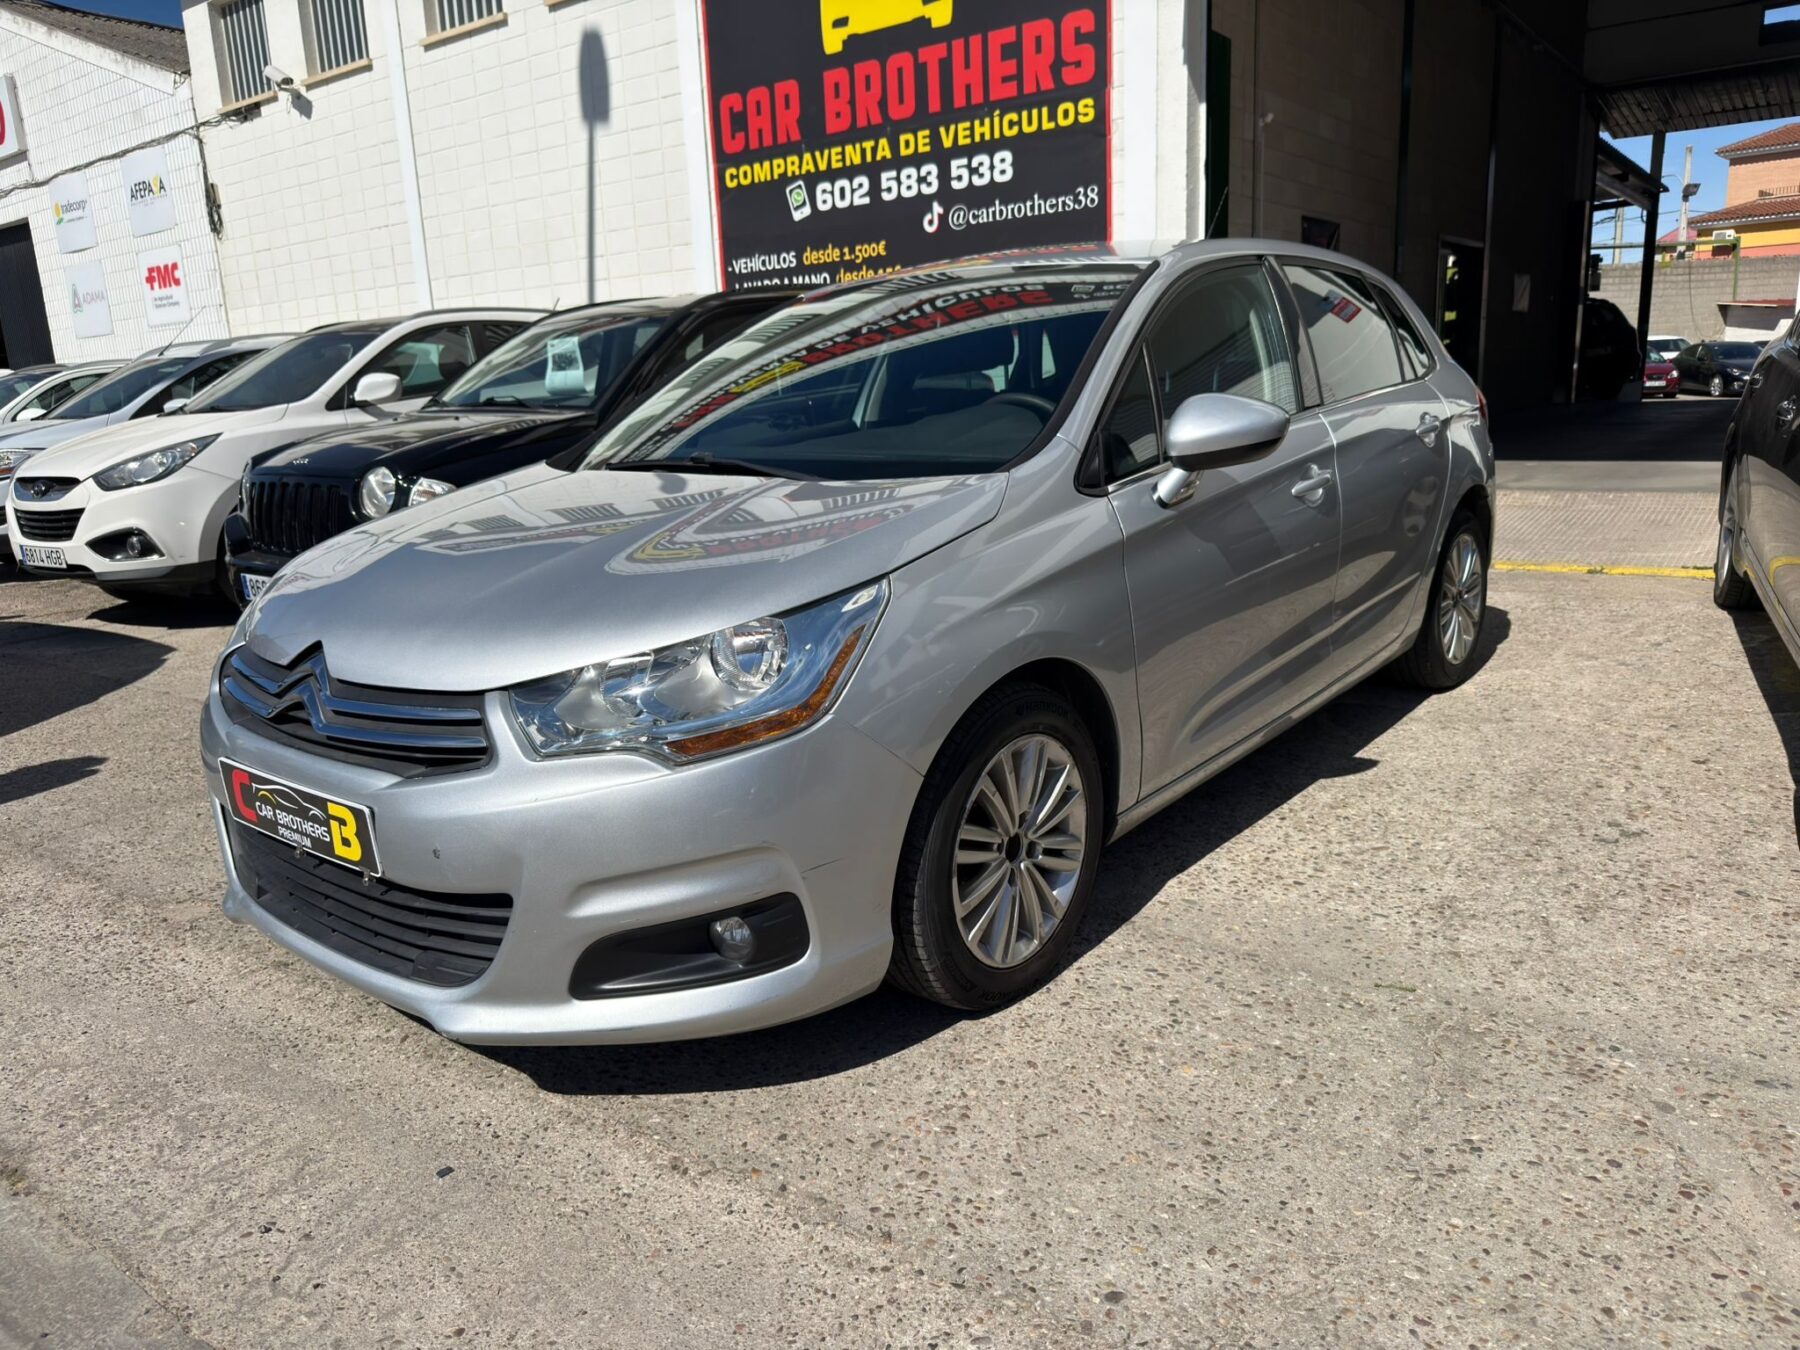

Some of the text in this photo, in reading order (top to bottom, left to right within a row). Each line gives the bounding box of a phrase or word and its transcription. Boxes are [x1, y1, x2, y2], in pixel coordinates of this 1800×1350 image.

[719, 9, 1097, 154] CAR BROTHERS
[724, 97, 1096, 189] COMPRAVENTA DE VEHÍCULOS
[815, 150, 1014, 212] 602 583 538
[948, 185, 1099, 230] @carbrothers38
[803, 243, 840, 266] desde
[843, 240, 887, 264] 1.500€
[145, 262, 181, 291] FMC
[44, 549, 63, 566] HGB
[255, 801, 331, 842] CAR BROTHERS
[277, 826, 312, 849] PREMIUM
